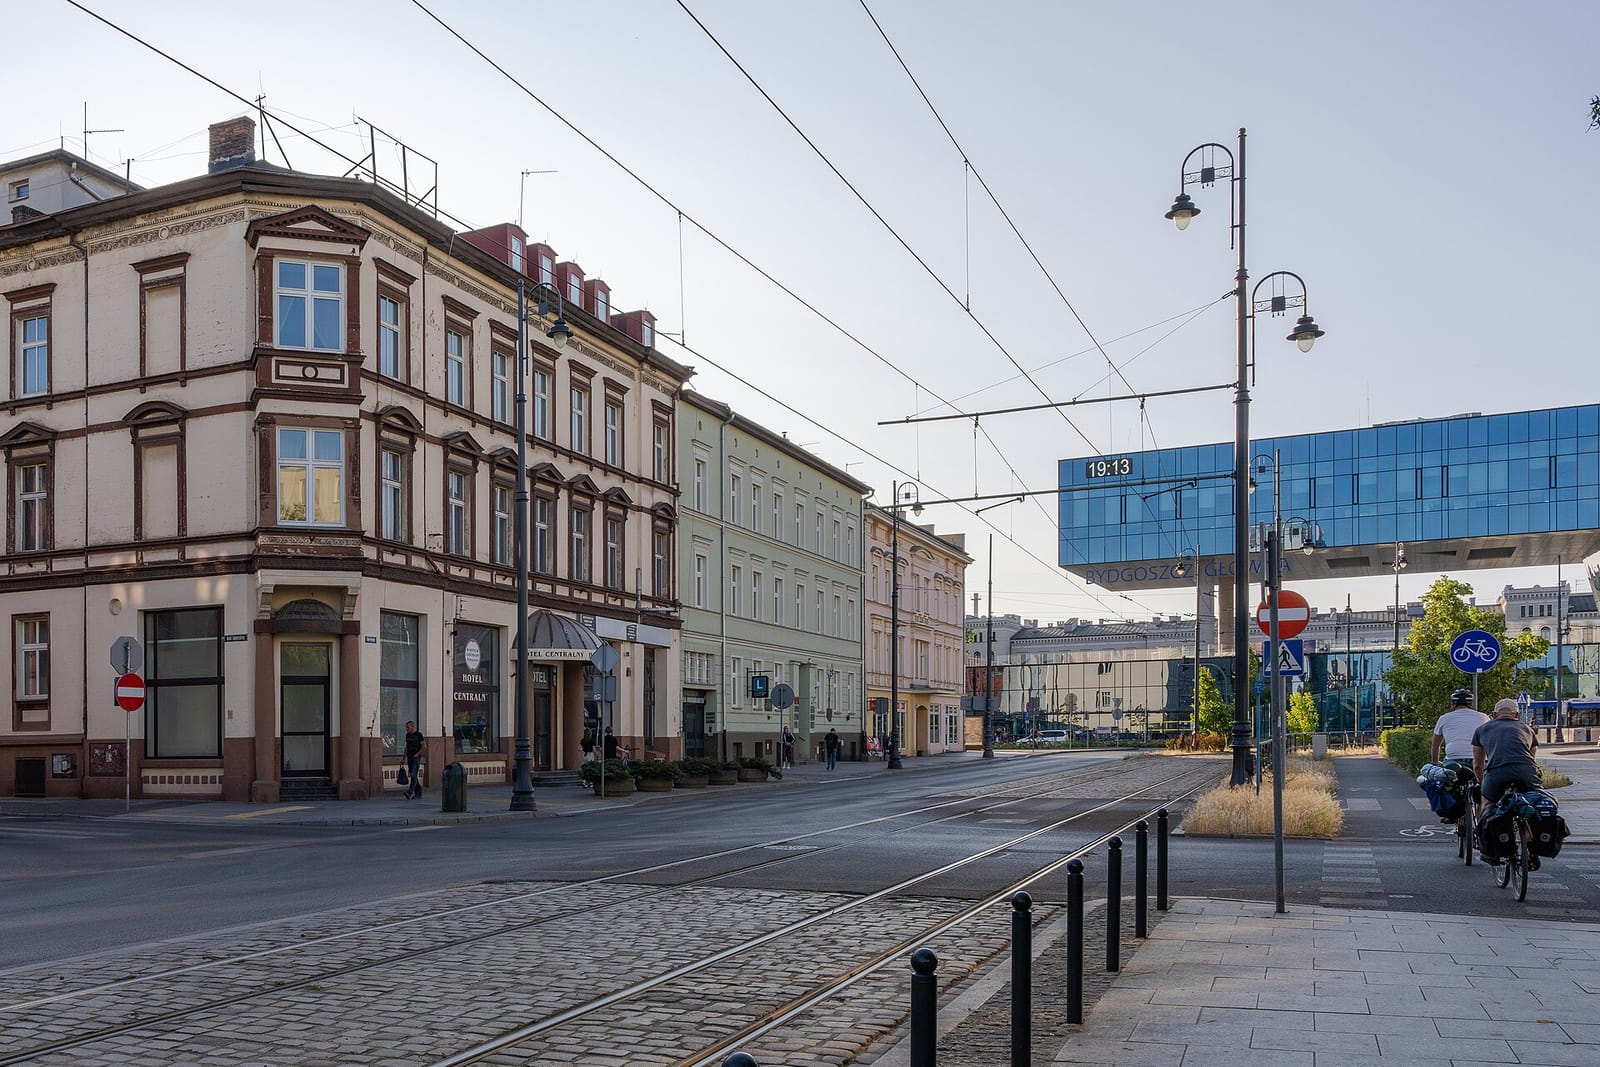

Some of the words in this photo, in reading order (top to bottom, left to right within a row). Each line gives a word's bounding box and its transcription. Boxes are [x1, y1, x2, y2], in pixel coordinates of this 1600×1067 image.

[1088, 458, 1130, 478] 19:13
[1085, 563, 1194, 585] BYDGOSZCZ
[462, 673, 484, 684] HOTEL
[453, 691, 488, 702] CENTRALN
